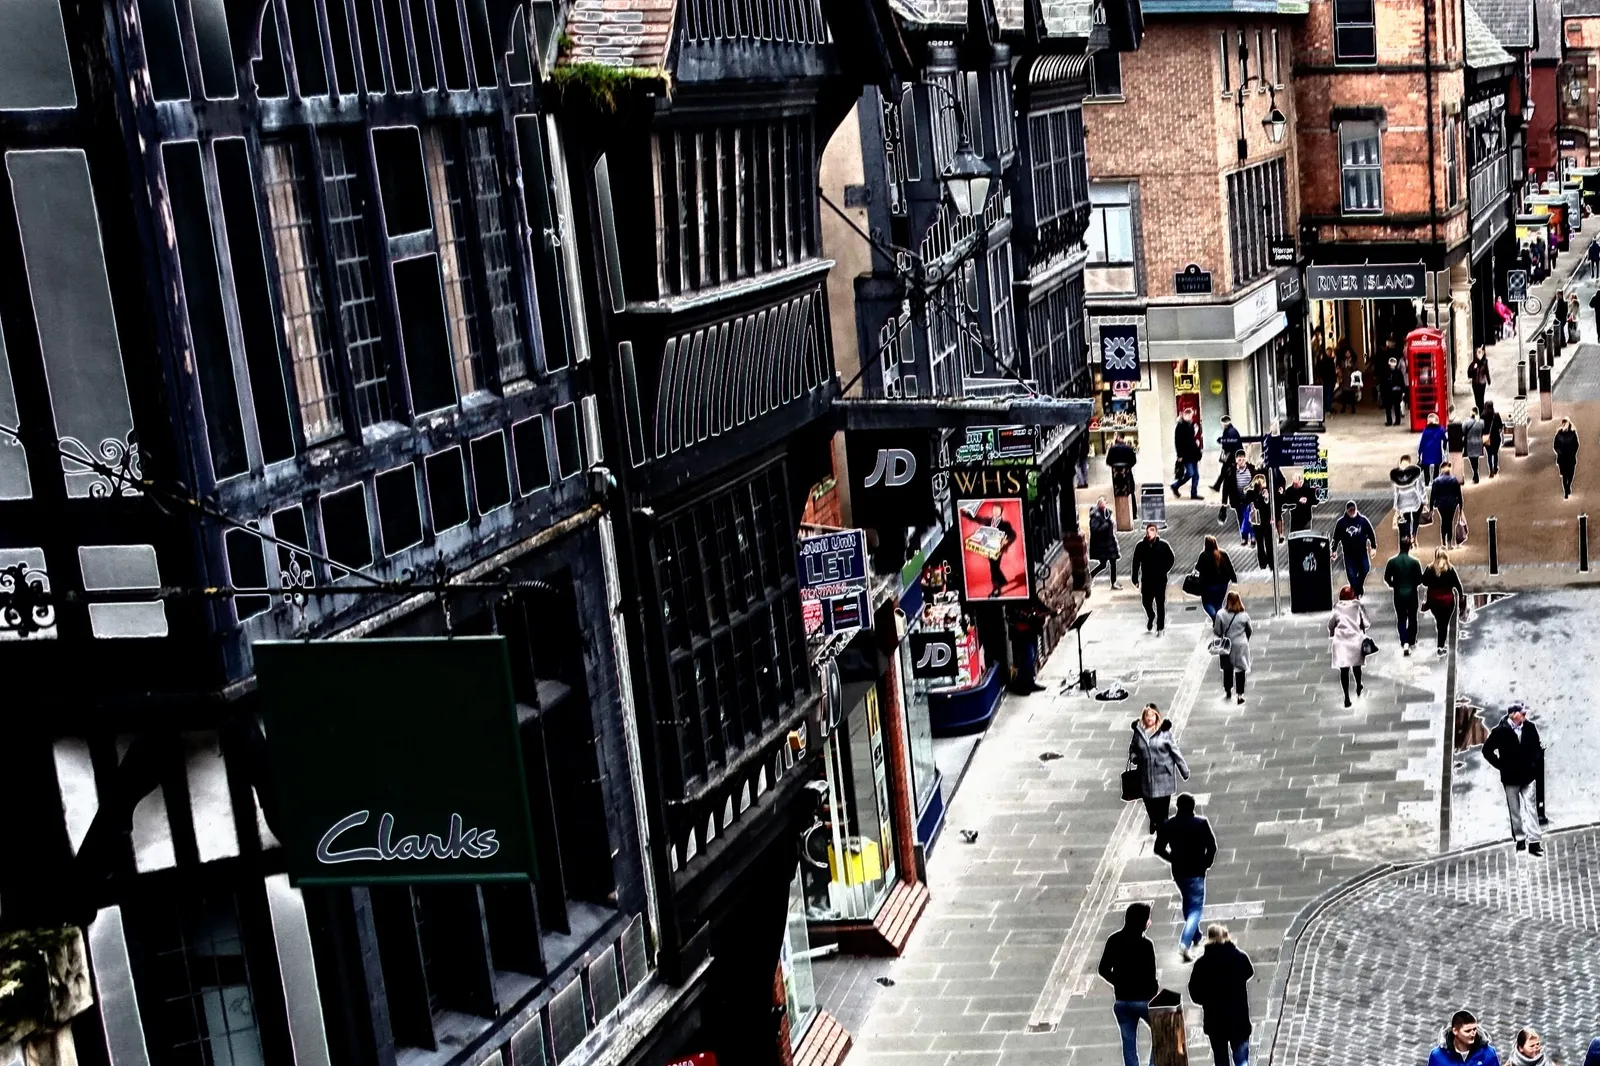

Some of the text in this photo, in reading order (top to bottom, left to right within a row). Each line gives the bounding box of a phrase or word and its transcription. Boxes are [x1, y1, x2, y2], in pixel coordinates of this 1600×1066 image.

[1317, 275, 1358, 292] RIVER
[1363, 274, 1415, 290] ISLAND
[864, 448, 917, 488] JD
[831, 534, 857, 550] Unit
[805, 547, 855, 585] LET
[917, 642, 952, 668] JD
[317, 810, 500, 864] Clarks
